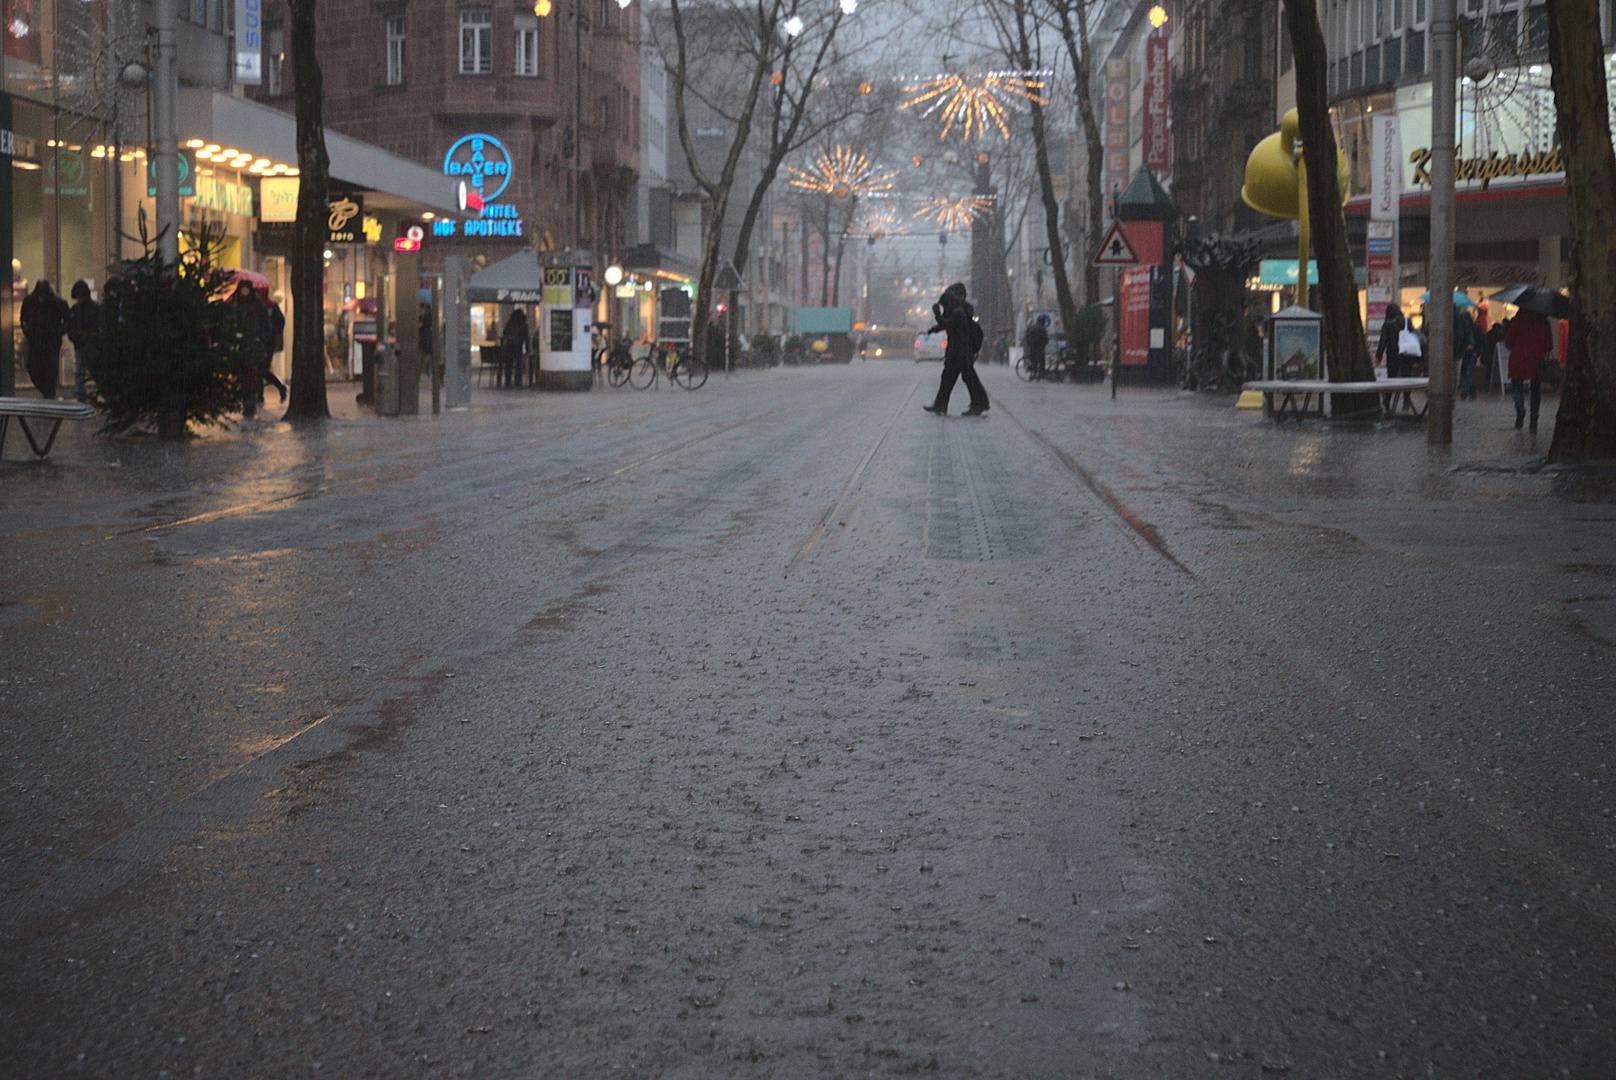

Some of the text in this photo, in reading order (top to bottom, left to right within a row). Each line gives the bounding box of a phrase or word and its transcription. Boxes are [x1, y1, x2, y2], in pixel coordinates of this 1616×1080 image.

[449, 161, 507, 175] BAYER
[1380, 119, 1396, 213] Kaiserpassage
[464, 219, 523, 236] APOTHEKE
